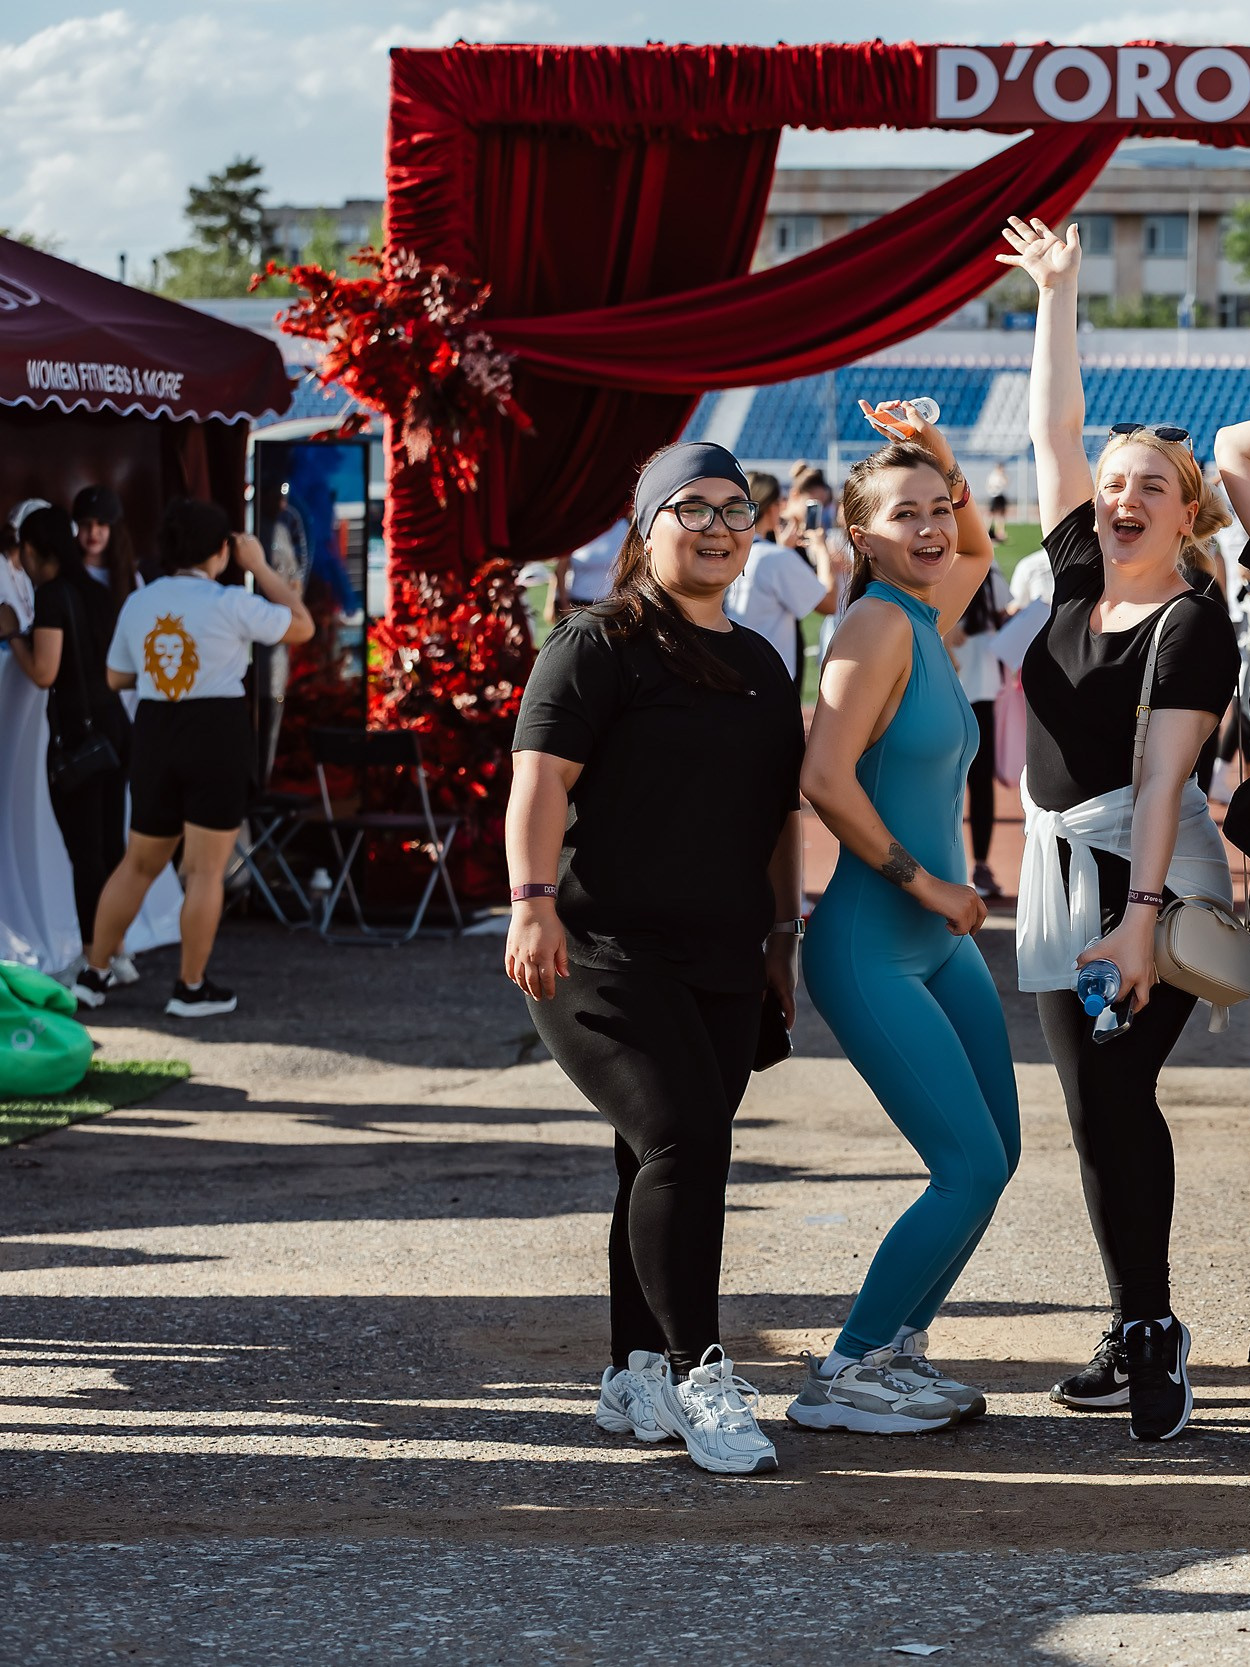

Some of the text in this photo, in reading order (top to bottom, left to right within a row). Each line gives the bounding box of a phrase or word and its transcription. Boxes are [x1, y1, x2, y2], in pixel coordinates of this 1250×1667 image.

[26, 359, 80, 391] WOMEN
[78, 362, 133, 395] FITNESS
[142, 369, 185, 400] MORE
